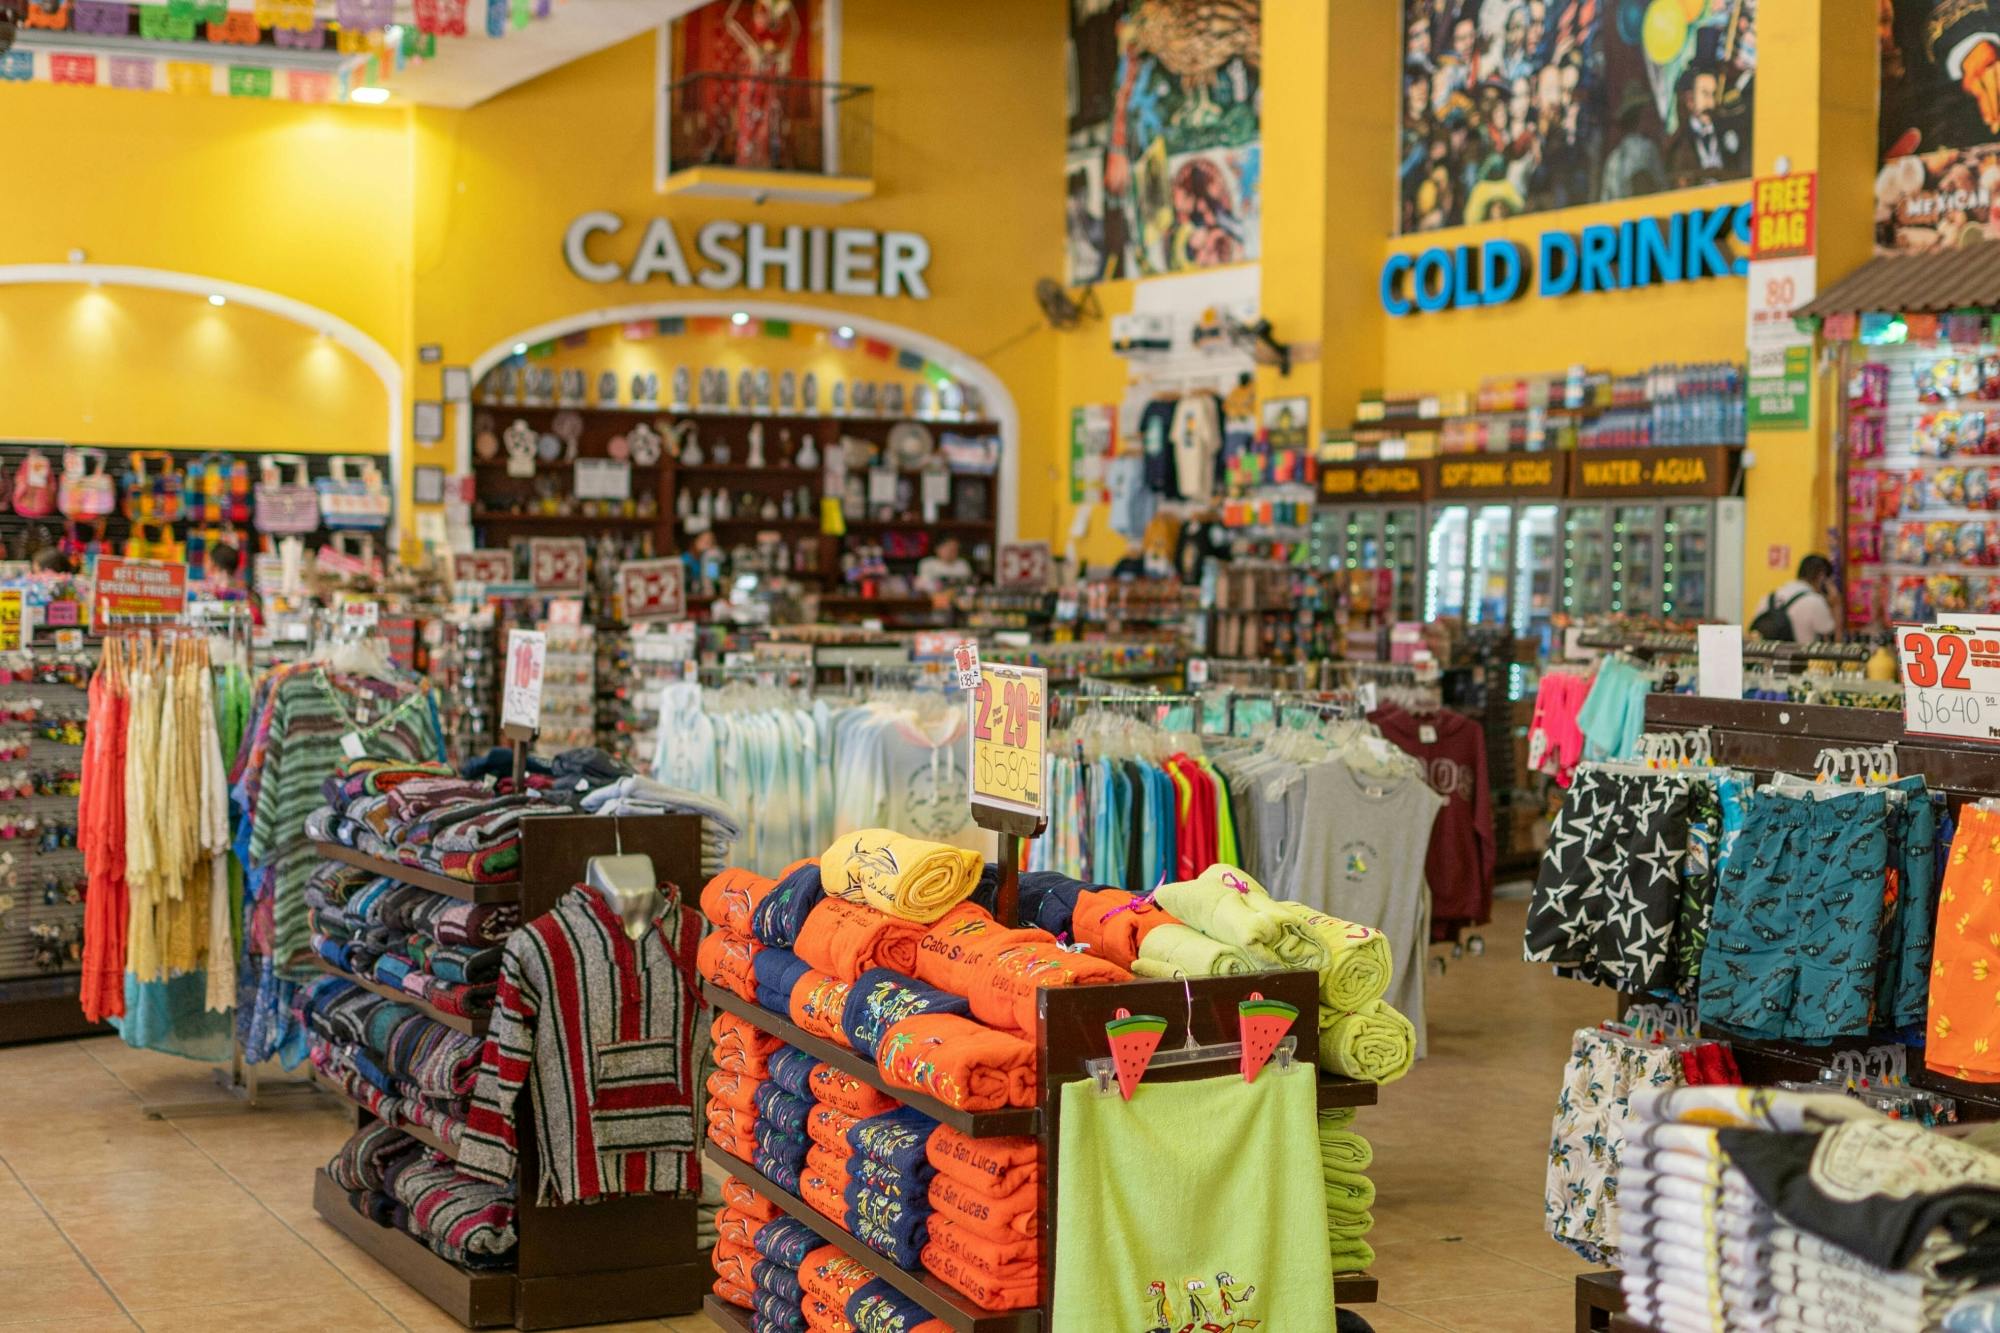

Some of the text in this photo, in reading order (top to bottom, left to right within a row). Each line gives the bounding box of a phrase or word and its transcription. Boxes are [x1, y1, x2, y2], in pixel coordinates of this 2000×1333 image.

[1759, 176, 1810, 214] FREE
[1759, 213, 1807, 250] BAG
[563, 211, 931, 300] CASHIER
[1381, 202, 1752, 318] COLD DRINKS
[1583, 459, 1642, 486] WATER
[1653, 457, 1707, 485] AGUA
[1904, 633, 1972, 690] 32
[975, 679, 992, 740] 2
[1003, 680, 1028, 749] 29
[1917, 689, 1980, 730] $640
[980, 744, 1028, 792] $580
[920, 934, 948, 956] Cabo
[935, 1139, 1007, 1178] abo San Lucas
[943, 1185, 958, 1205] San
[957, 1194, 990, 1220] Lucas
[944, 1258, 959, 1278] San
[959, 1266, 985, 1300] Lucas
